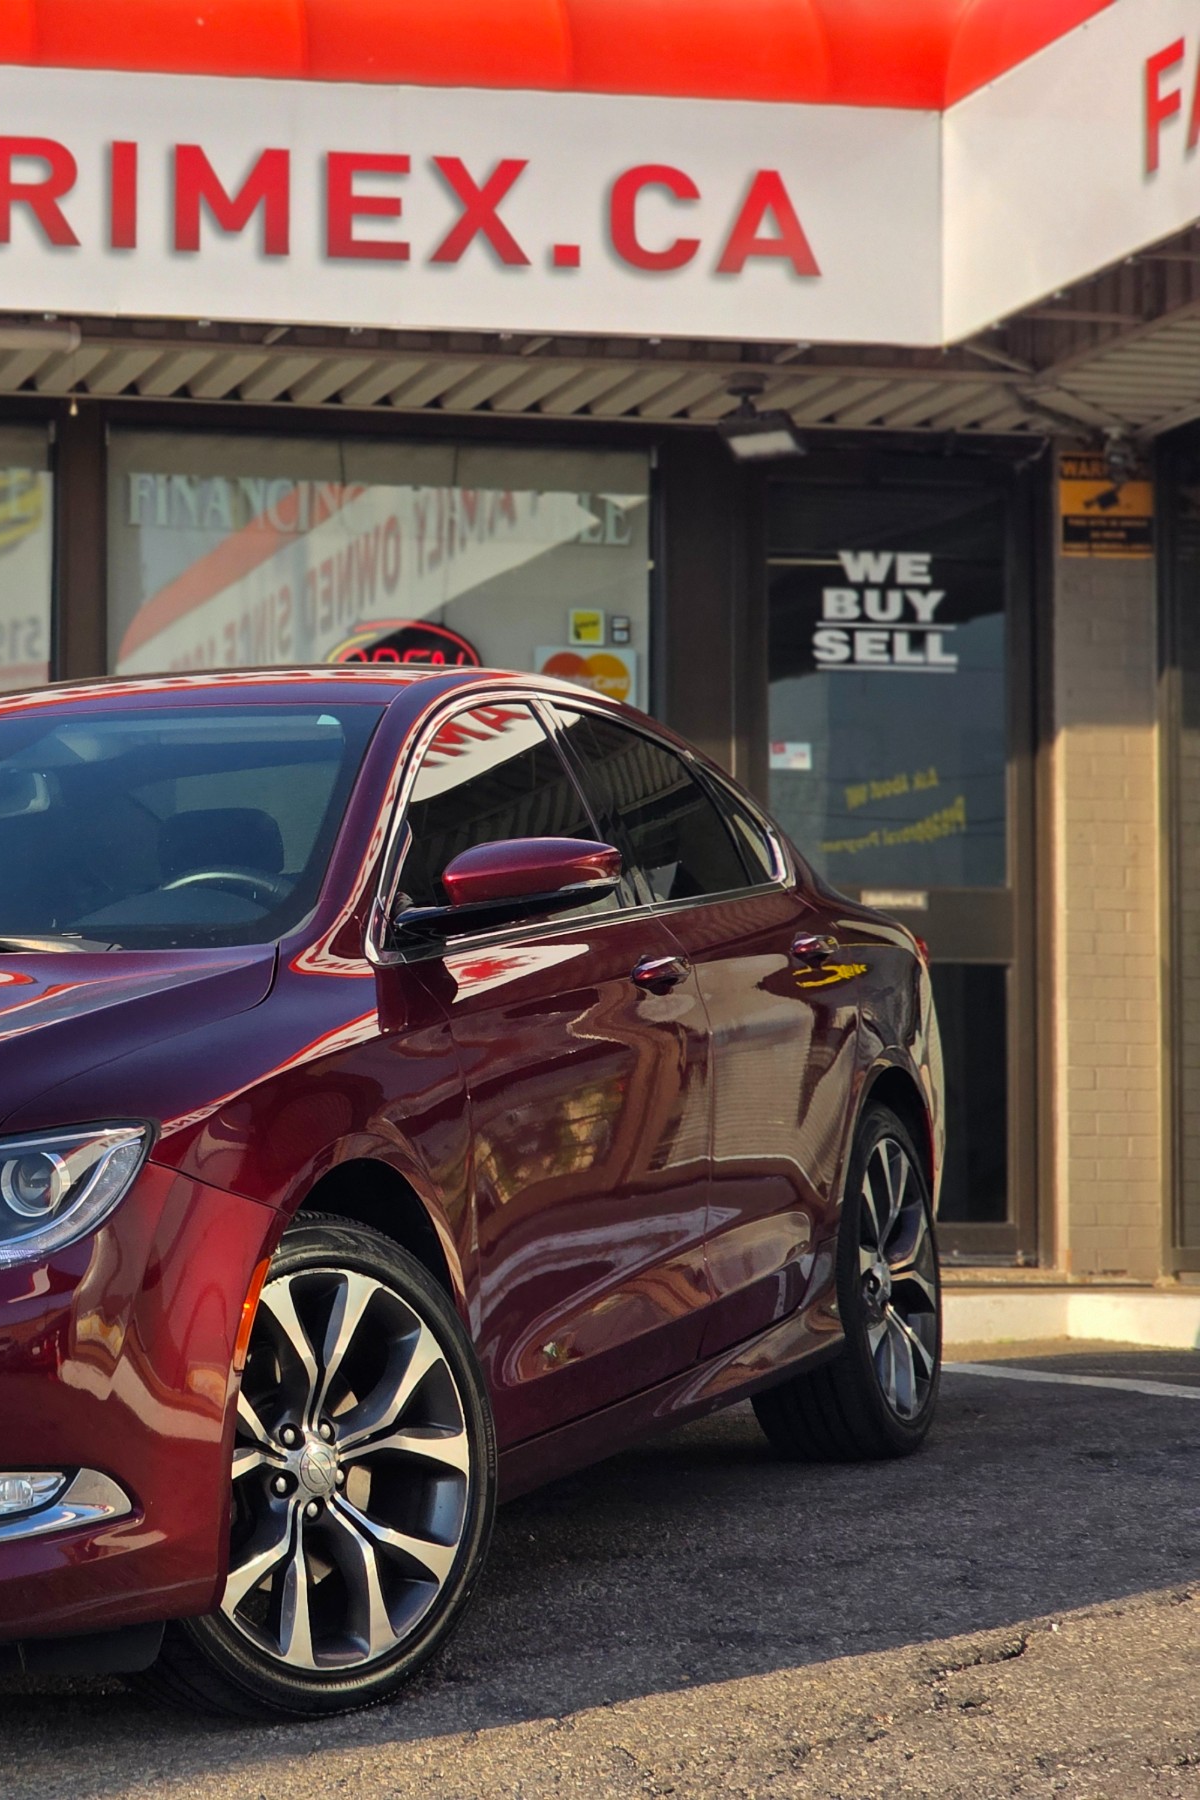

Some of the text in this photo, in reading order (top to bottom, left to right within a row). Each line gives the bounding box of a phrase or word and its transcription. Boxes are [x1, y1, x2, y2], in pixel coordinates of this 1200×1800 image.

[838, 550, 932, 584] WE
[822, 587, 945, 623] BUY
[812, 629, 958, 664] SELL
